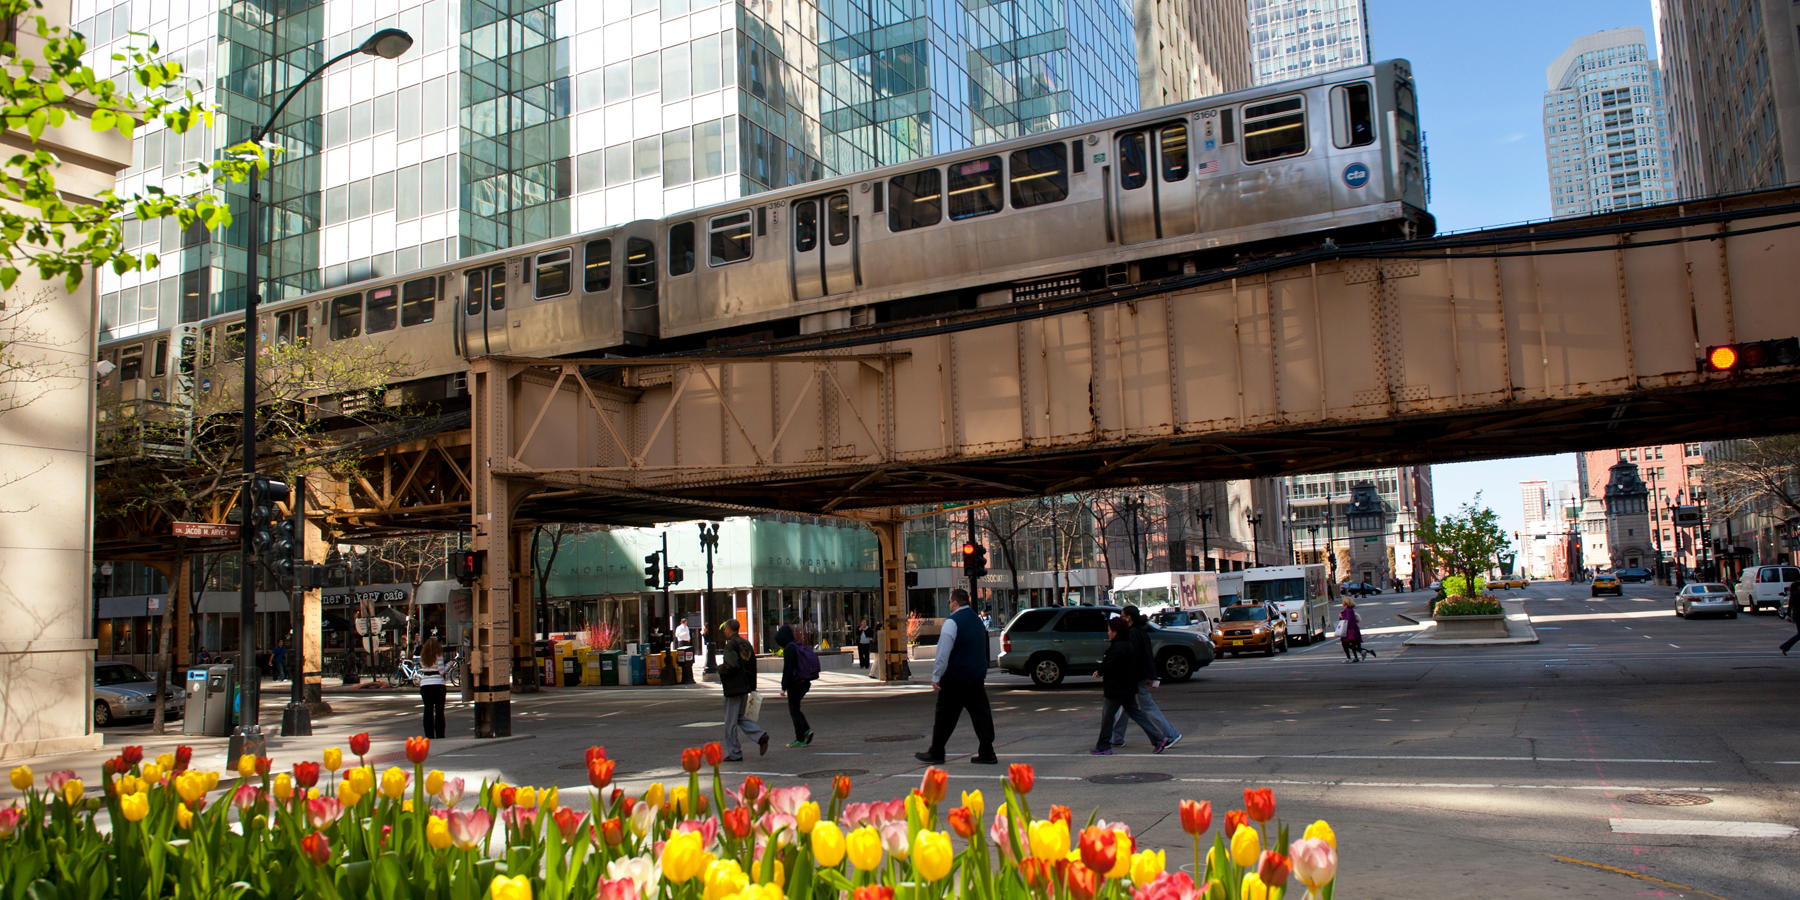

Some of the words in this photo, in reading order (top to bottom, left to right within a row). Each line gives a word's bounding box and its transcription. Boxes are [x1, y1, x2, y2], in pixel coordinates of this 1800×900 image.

[1194, 109, 1217, 121] 3160
[1346, 170, 1366, 180] cta
[768, 200, 786, 210] 3160
[769, 557, 791, 565] 200
[571, 565, 627, 574] NORTH
[1179, 574, 1209, 607] FedEx
[344, 592, 380, 604] bkery
[383, 589, 404, 601] cafe
